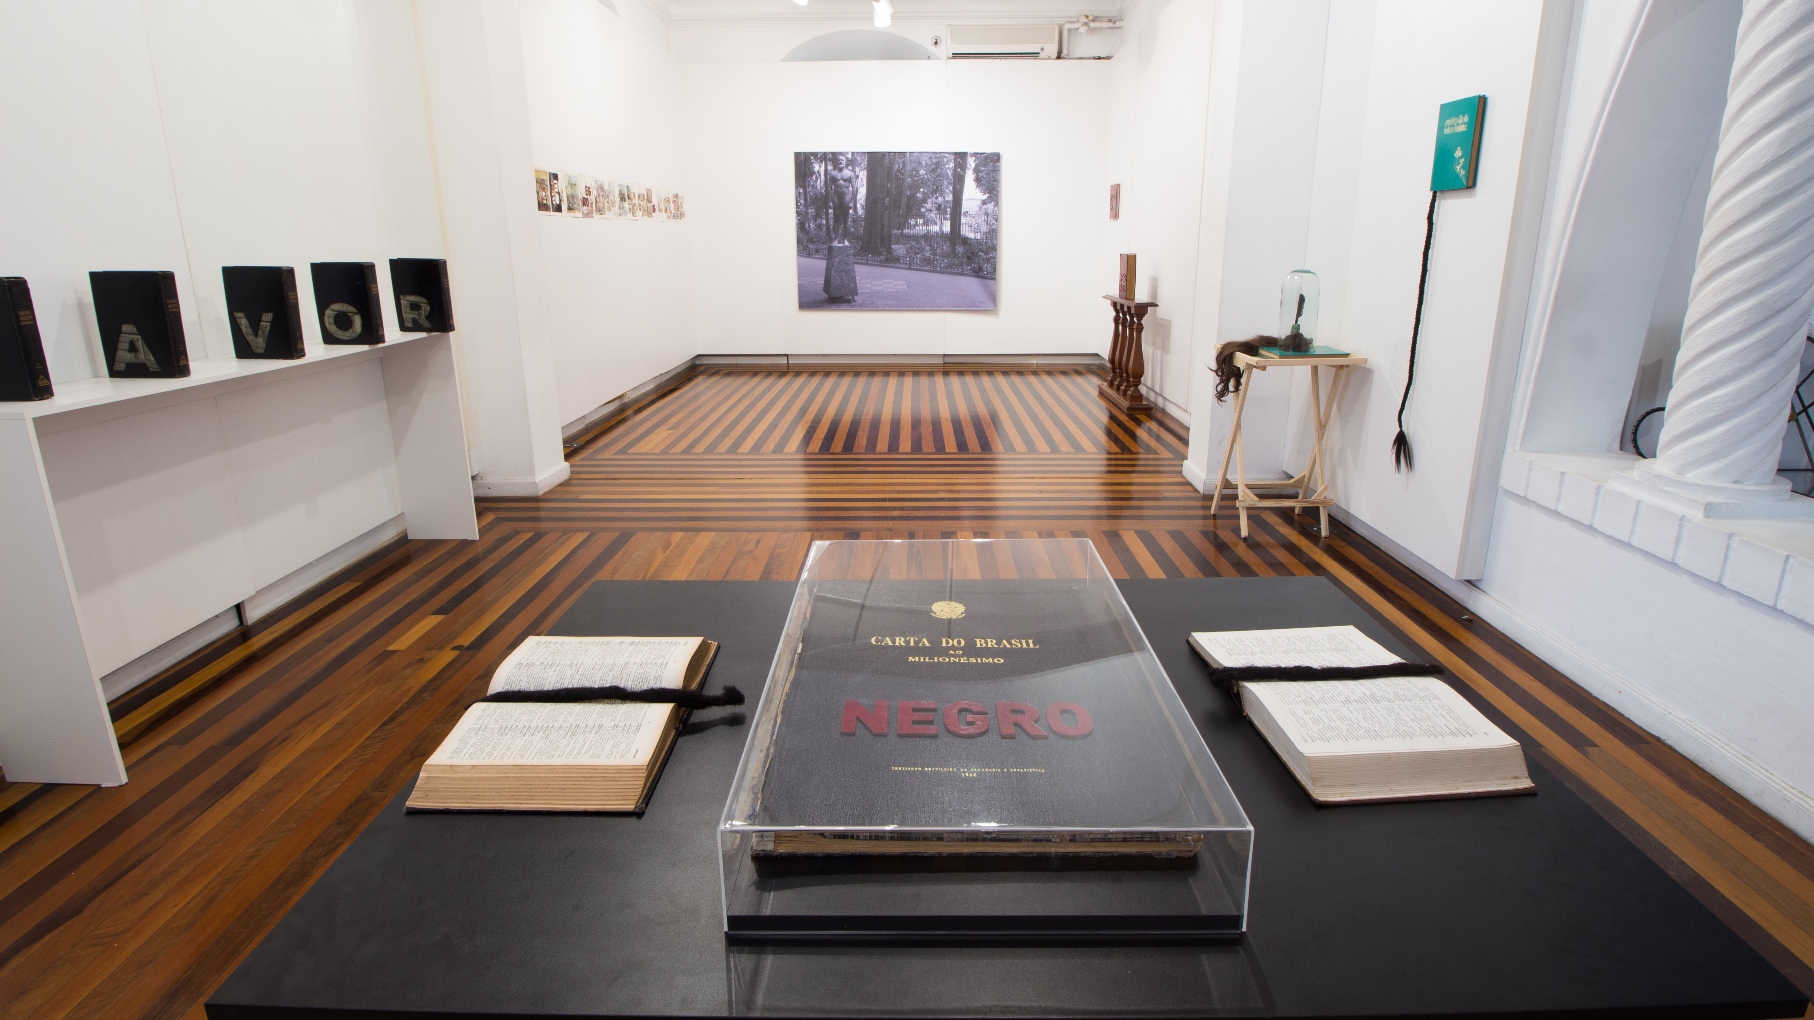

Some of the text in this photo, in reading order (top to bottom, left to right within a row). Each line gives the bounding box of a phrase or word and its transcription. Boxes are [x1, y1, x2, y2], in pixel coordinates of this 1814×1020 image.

[113, 294, 433, 372] A V O R
[870, 635, 1040, 649] CARTA DO BRASIL
[907, 656, 1005, 664] MILIONÉSIMO
[840, 700, 1094, 738] NEGRO
